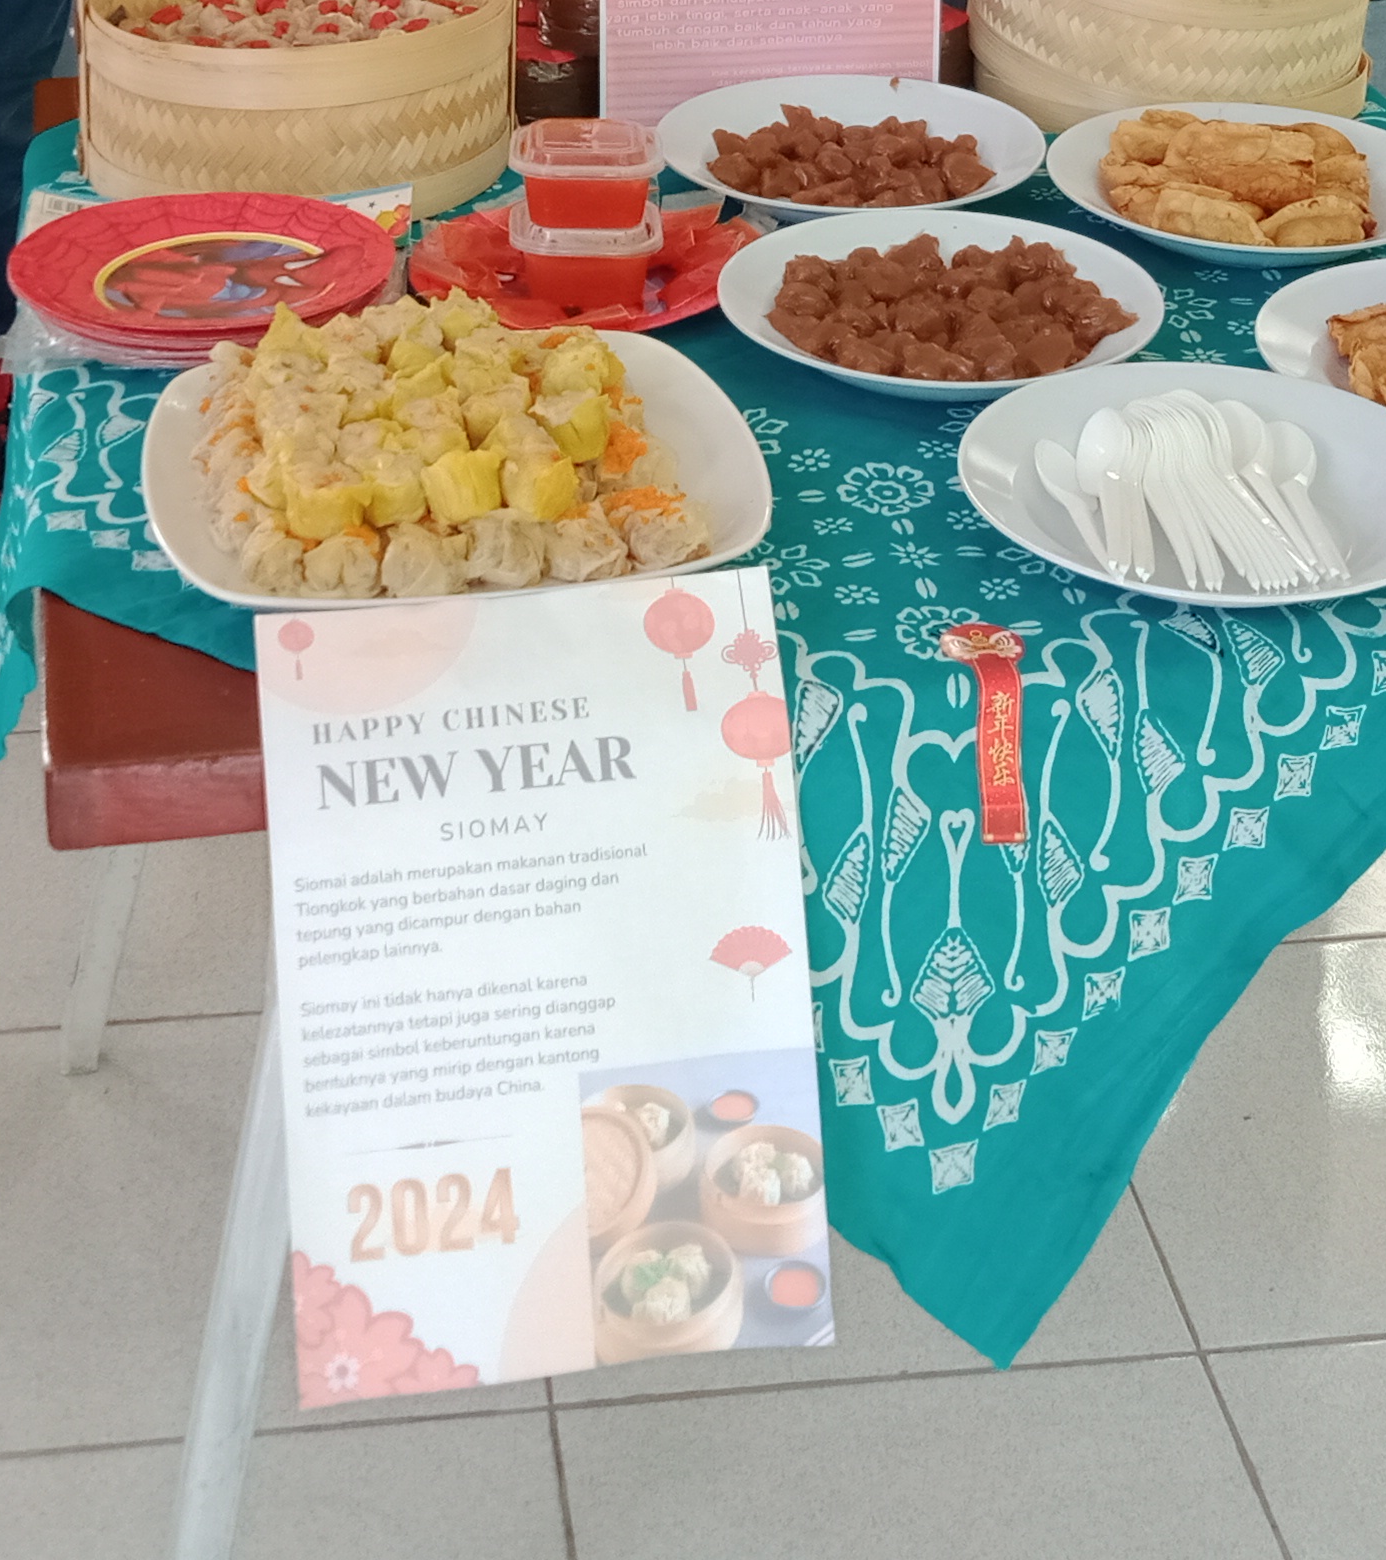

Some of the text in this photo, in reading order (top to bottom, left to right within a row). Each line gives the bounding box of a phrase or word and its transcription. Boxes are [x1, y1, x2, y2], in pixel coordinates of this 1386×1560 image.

[605, 14, 639, 25] yang
[646, 11, 679, 21] lebih
[734, 7, 771, 18] serta
[778, 3, 852, 16] anak-anak
[860, 2, 893, 14] yang
[617, 18, 882, 37] tumbuh dengan baik dan tahun yang
[653, 33, 843, 50] lebih baik dari sebelumnya
[788, 64, 832, 73] ternyata
[836, 62, 892, 71] merupakan
[896, 60, 930, 70] simbol
[313, 696, 590, 745] HAPPY CHINESE
[317, 735, 637, 810] NEW YEAR
[440, 812, 548, 842] SIOMAY
[294, 843, 648, 892] Siomai adalah merupakan makanan tradisional
[295, 872, 620, 917] Tiongkok yang berbahan dasar daging dan
[297, 901, 581, 943] tepung yang dicampur dengan bahan
[298, 940, 442, 970] pelengkap lainnya.
[301, 975, 587, 1017] Siomay ini tidak hanya dikenal karena
[302, 996, 616, 1042] kelezatannya tetapi juga sering dianggap
[303, 1023, 595, 1068] sebagai simbol keberuntungan karena
[303, 1048, 599, 1093] bentuknya yang mirip dengan kantong
[304, 1079, 545, 1118] kekayaan dalam budaya China.
[347, 1166, 519, 1263] 2024
